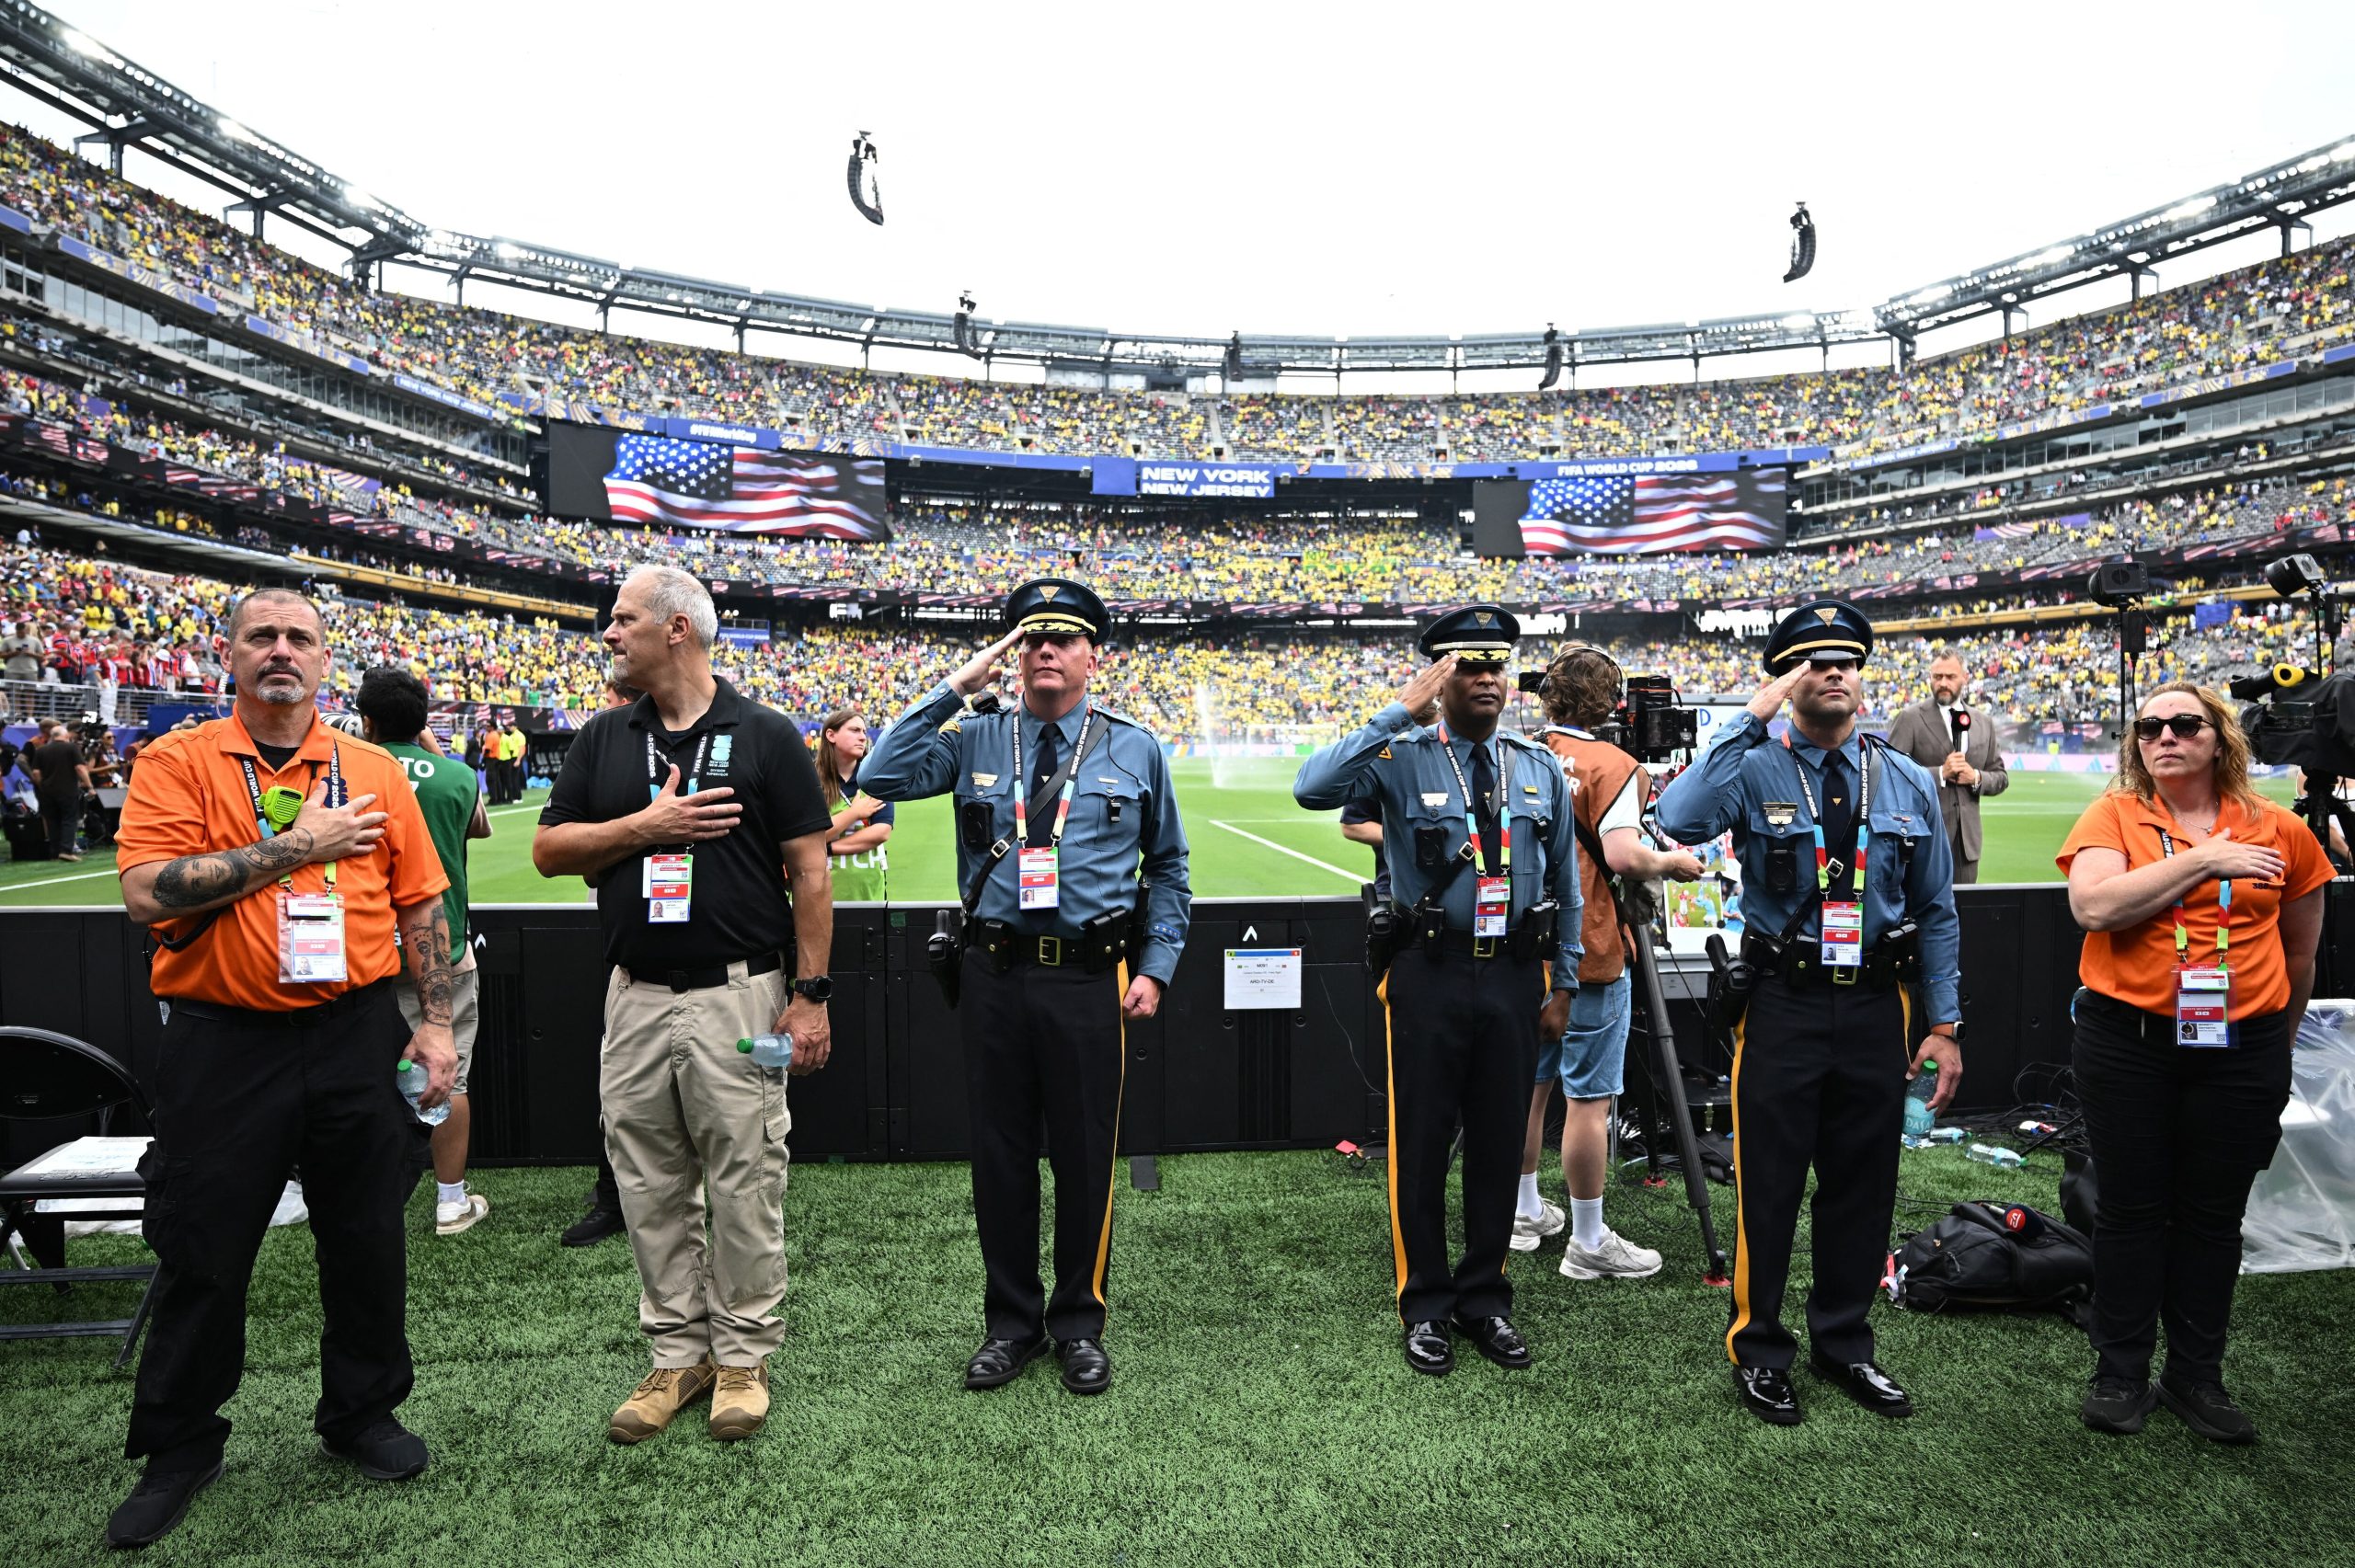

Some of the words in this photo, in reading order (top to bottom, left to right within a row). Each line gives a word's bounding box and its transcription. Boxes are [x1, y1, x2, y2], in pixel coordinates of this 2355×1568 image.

[1142, 466, 1199, 482] NEW
[1202, 469, 1270, 484] YORK
[1557, 465, 1584, 476] FIFA
[1584, 463, 1628, 475] WORLD
[1629, 462, 1654, 474] CUP
[1654, 459, 1698, 472] 2026
[1142, 483, 1189, 495] NEW
[1191, 484, 1270, 498] JERSEY
[1079, 726, 1088, 745] WORLD
[696, 736, 707, 759] WORLD
[1075, 744, 1084, 756] CUP
[243, 760, 253, 773] CUP
[693, 759, 703, 773] FIFA
[1445, 746, 1453, 757] FIFA
[1450, 756, 1462, 775] WORLD
[1457, 775, 1465, 786] CUP
[247, 773, 260, 797] WORLD
[1803, 784, 1812, 796] CUP
[331, 784, 339, 809] 2026
